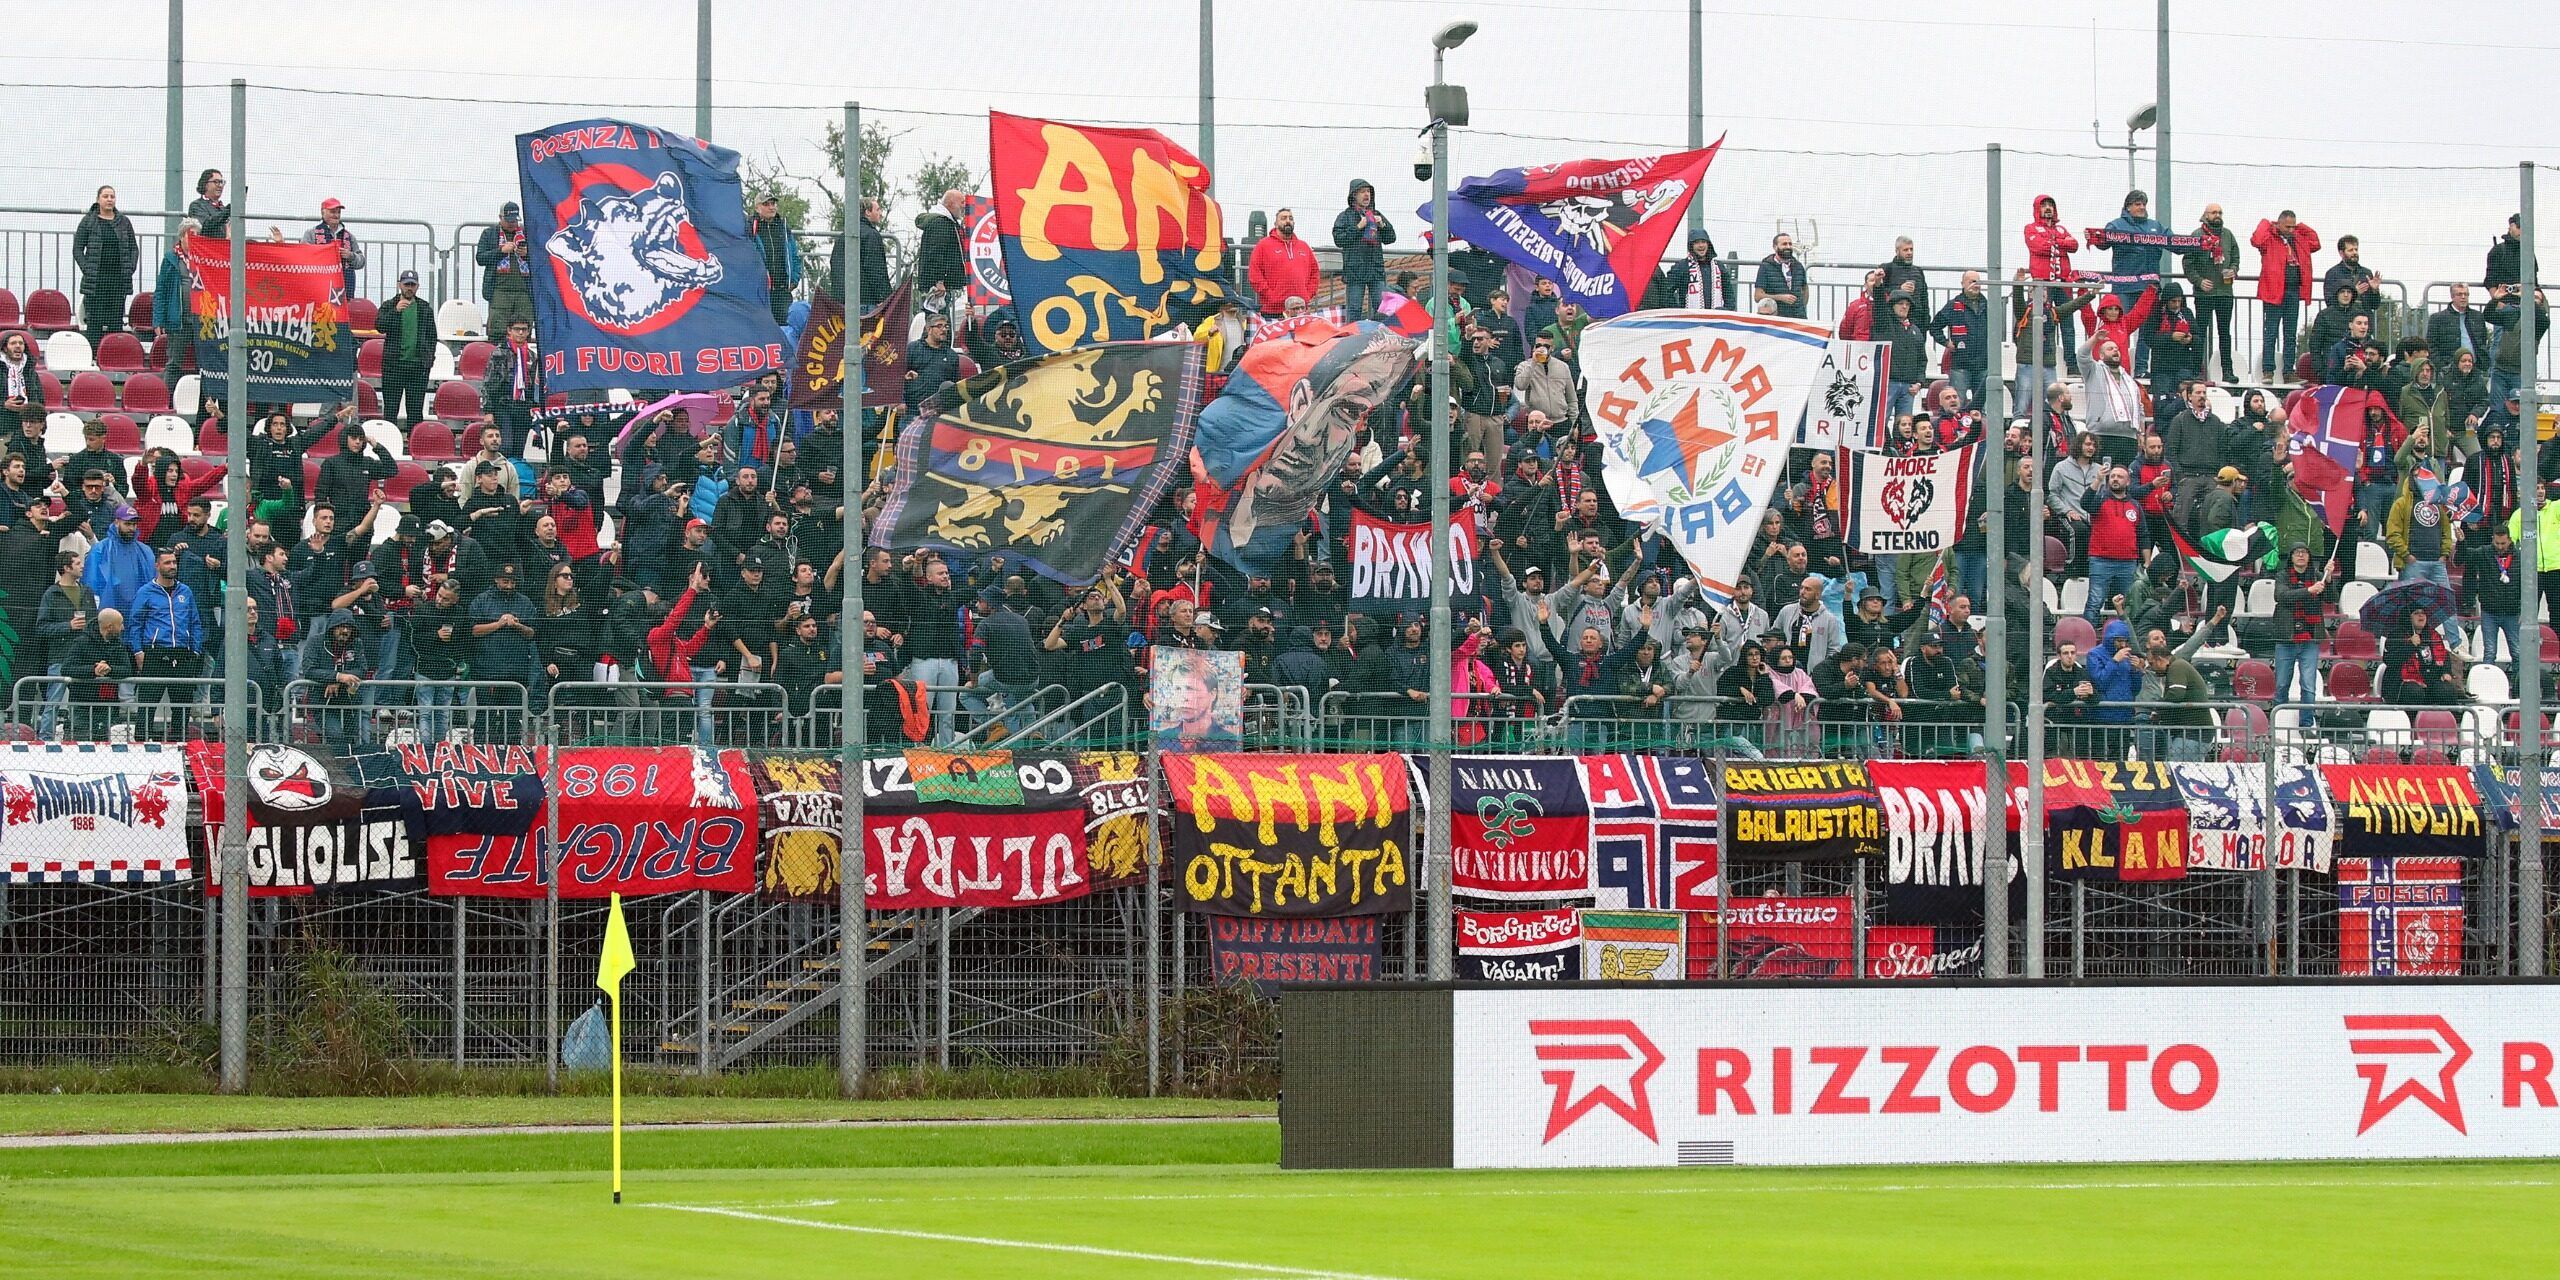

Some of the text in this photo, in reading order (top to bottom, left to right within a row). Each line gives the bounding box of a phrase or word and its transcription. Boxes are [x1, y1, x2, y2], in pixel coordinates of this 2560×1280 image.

[214, 293, 315, 348] AANTEA
[250, 349, 274, 373] 30
[576, 346, 684, 377] FUORI
[696, 343, 785, 374] SEDE
[1884, 454, 1939, 477] AMORE
[1872, 530, 1941, 552] ETERNO
[1351, 522, 1474, 599] BRANO
[412, 770, 518, 810] VIVE
[541, 764, 660, 798] 198
[1458, 767, 1543, 792] TOWN
[1725, 763, 1867, 791] BRIGATA
[2043, 758, 2172, 791] LUZZI
[29, 771, 133, 829] AMANTEA
[1188, 754, 1393, 847] ANNI
[2348, 775, 2481, 837] 4MIGLIA
[71, 815, 95, 832] 1986
[1737, 804, 1878, 842] BALAUSTRA
[205, 819, 416, 887] VGLIOLISE
[1451, 846, 1587, 883] COMMEND
[2062, 827, 2182, 870] KLAN
[1184, 839, 1406, 914] OTTANTA
[2352, 885, 2449, 906] FOSSA
[1216, 917, 1376, 945] DIFFIDATI
[1463, 909, 1578, 945] BORGHETTI
[1218, 951, 1373, 981] PRESENTI
[1874, 935, 1985, 980] Stoned
[1696, 1043, 2219, 1116] RIZZOTTO
